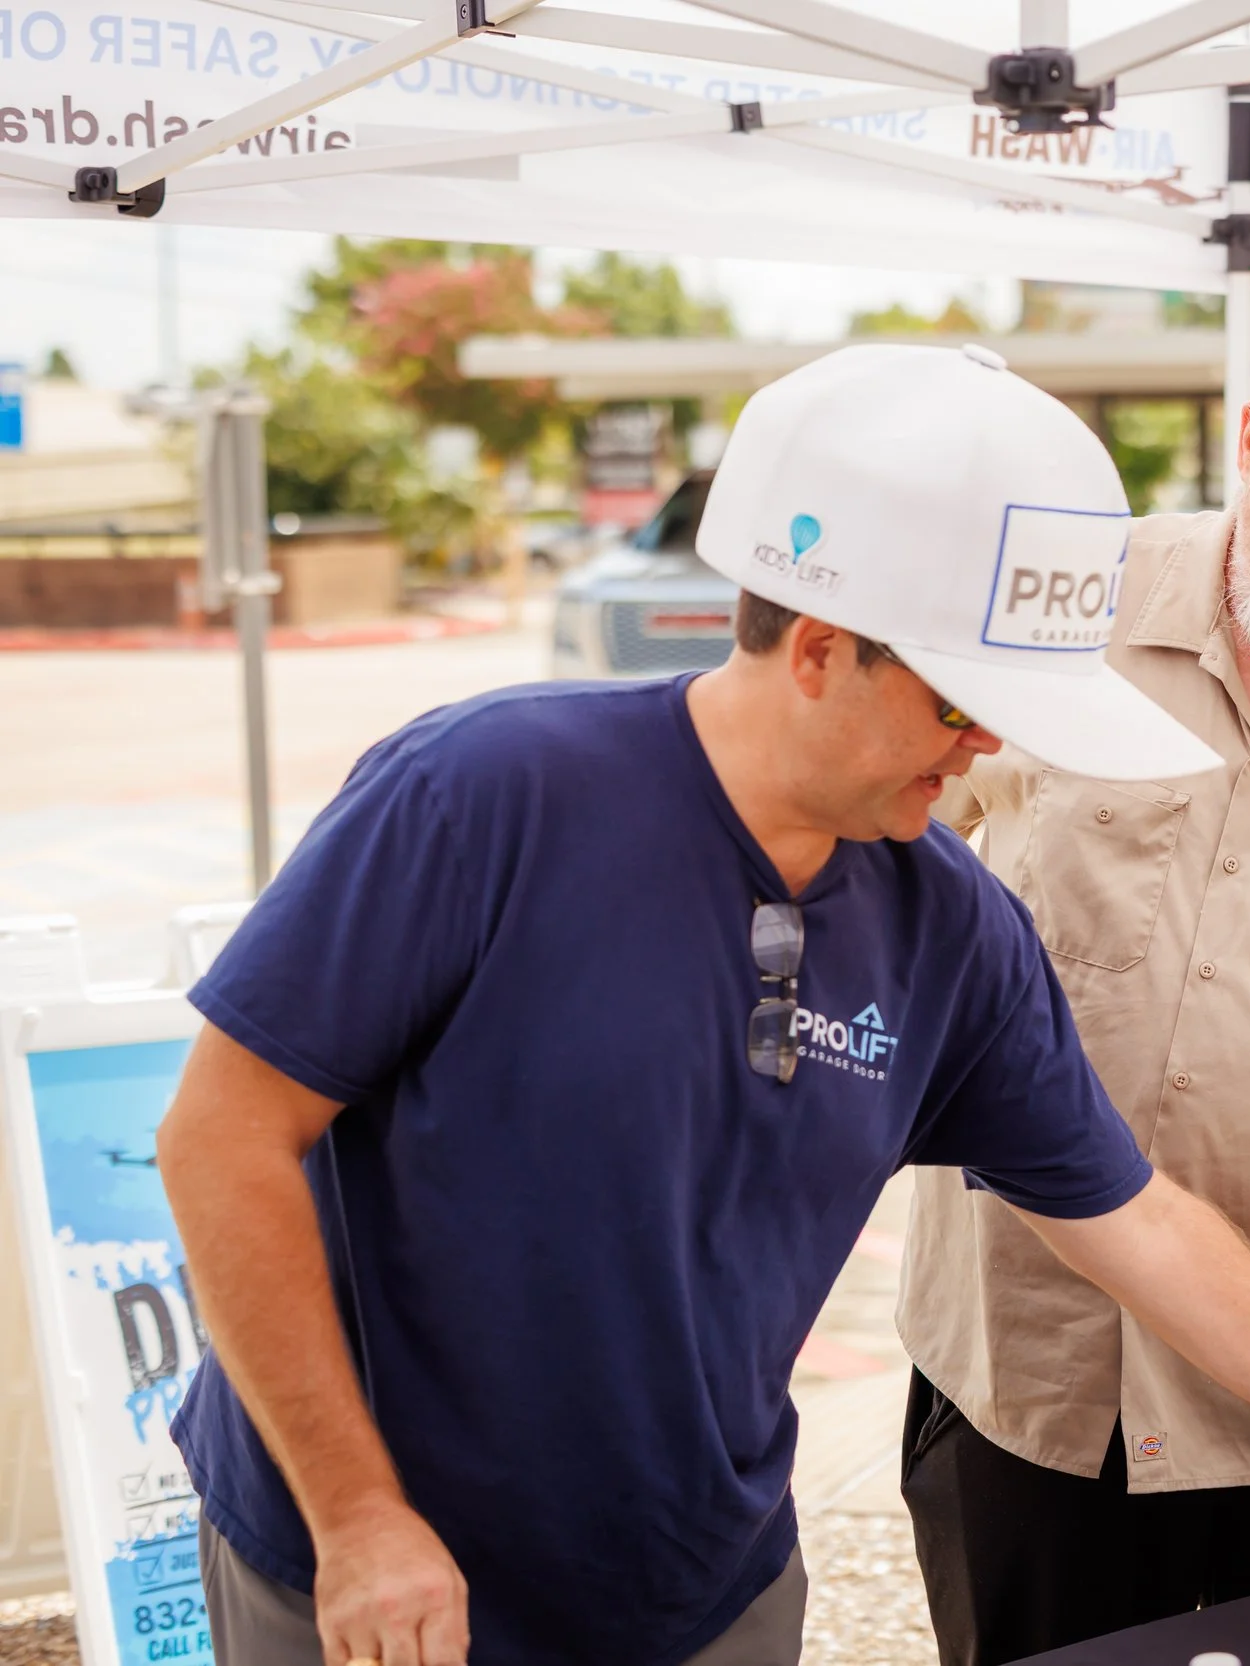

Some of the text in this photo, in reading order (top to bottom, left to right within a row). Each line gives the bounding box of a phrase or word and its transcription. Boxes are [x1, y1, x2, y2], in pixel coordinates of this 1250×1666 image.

[754, 541, 839, 589] KIDS LIFT
[796, 1045, 890, 1082] GARAGE DOOR
[148, 1635, 191, 1662] CALL
